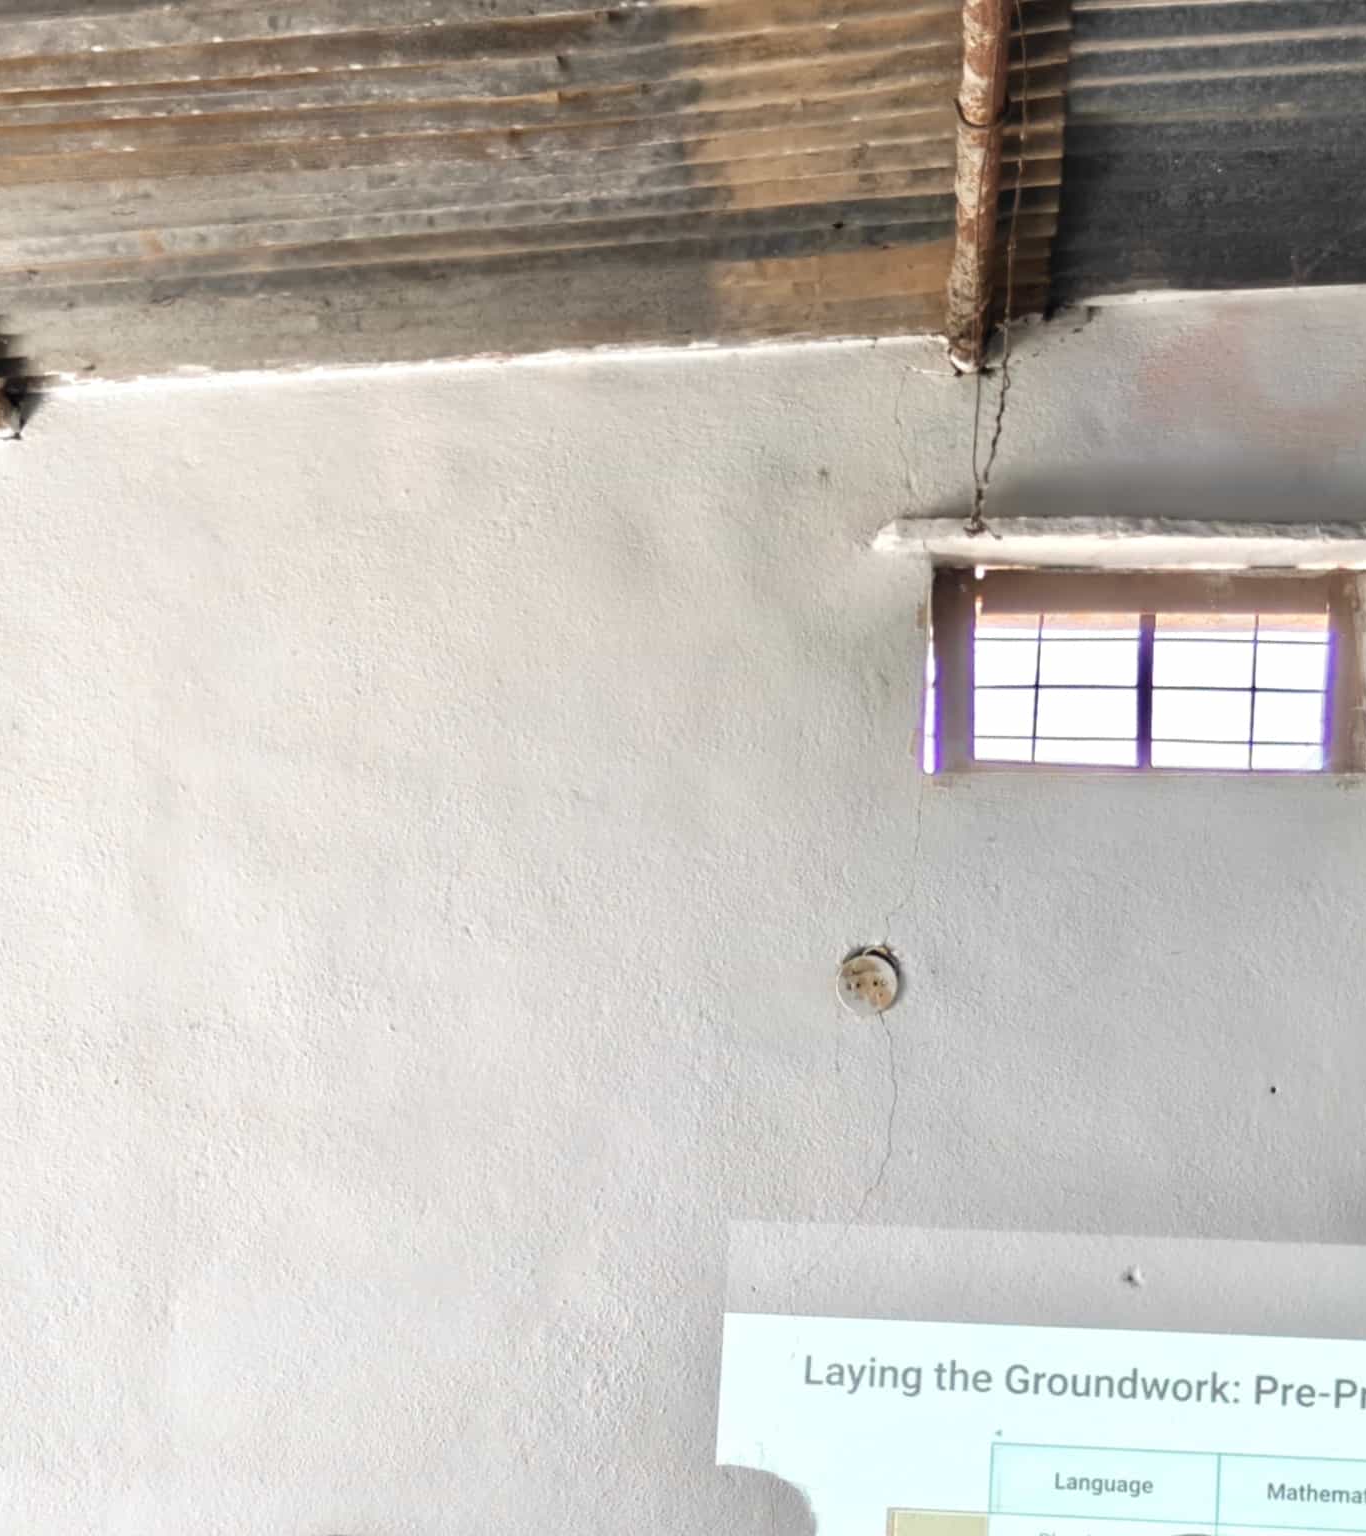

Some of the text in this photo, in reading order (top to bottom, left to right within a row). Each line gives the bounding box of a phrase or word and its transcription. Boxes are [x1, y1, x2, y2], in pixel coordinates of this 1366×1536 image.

[804, 1354, 922, 1397] Laying
[934, 1359, 992, 1393] the
[1005, 1364, 1240, 1404] Groundwork:
[1055, 1472, 1154, 1497] Language
